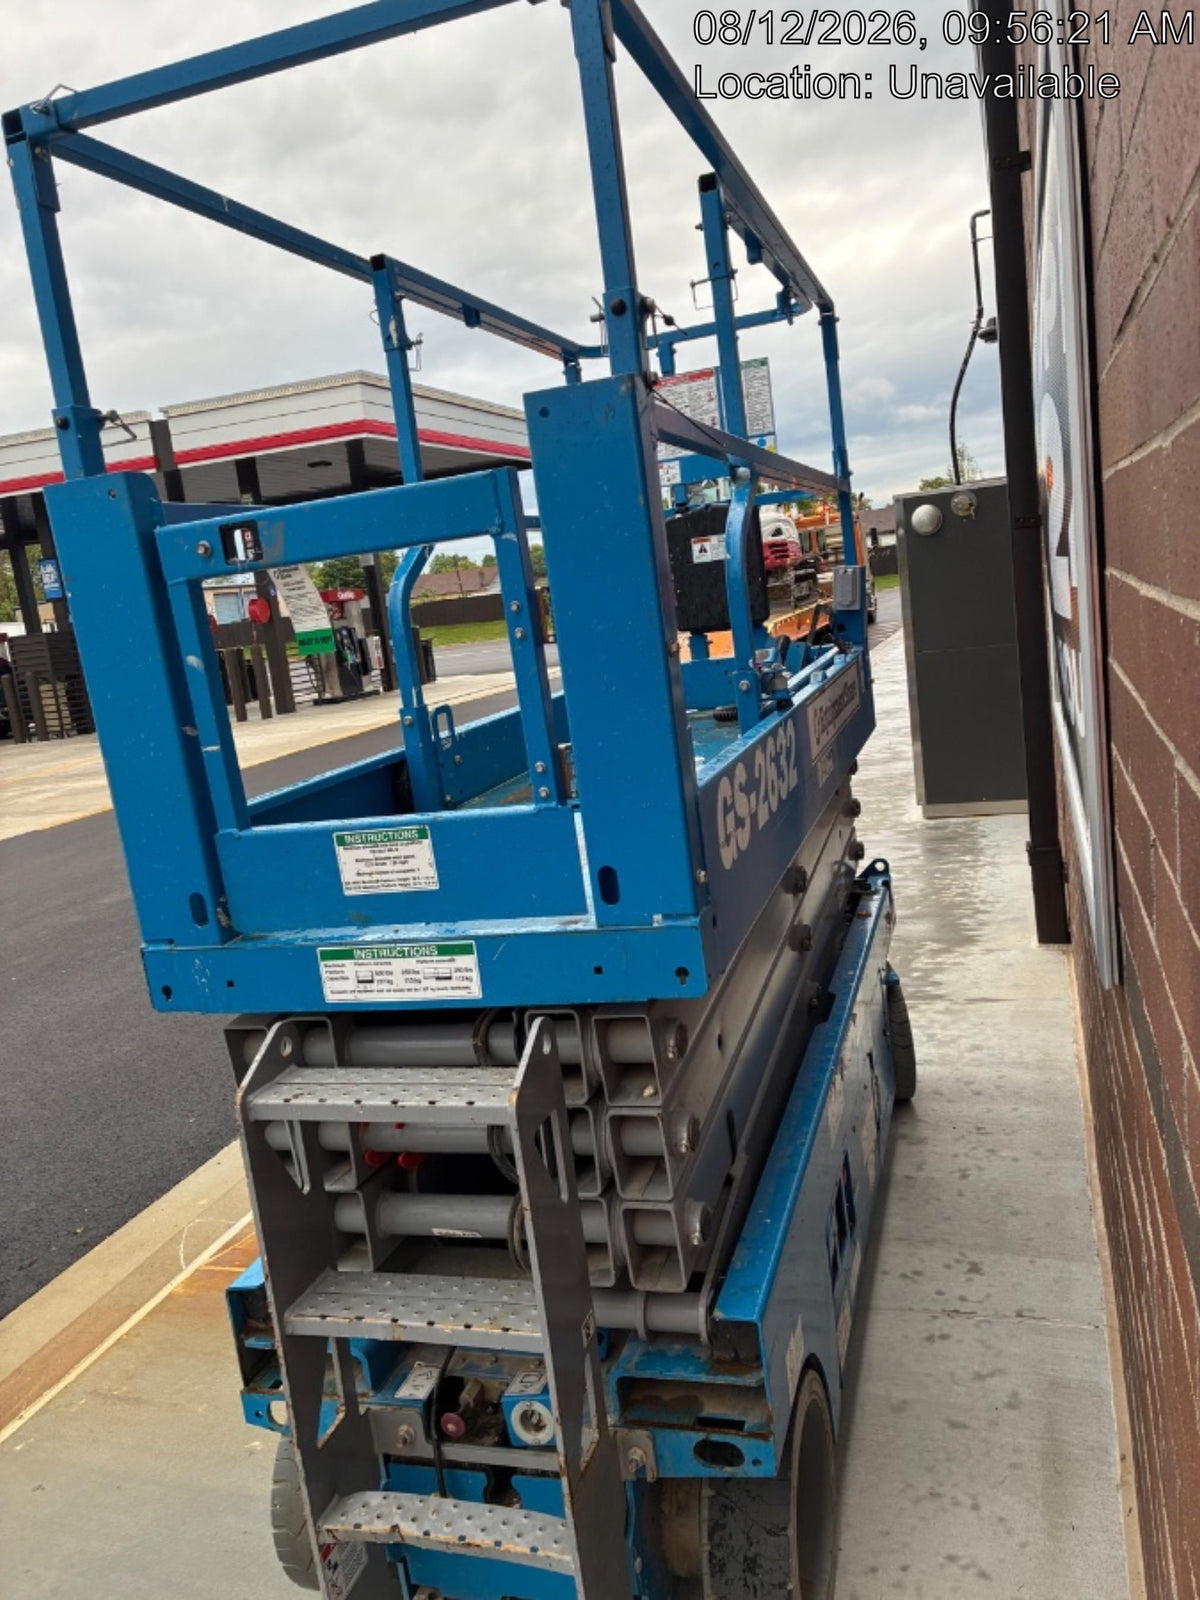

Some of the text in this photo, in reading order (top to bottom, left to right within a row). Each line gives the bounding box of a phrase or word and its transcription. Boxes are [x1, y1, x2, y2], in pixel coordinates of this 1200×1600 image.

[717, 718, 798, 870] GS-2632
[344, 829, 419, 843] INSTRUCTIONS
[353, 945, 438, 959] INSTRUCTIONS
